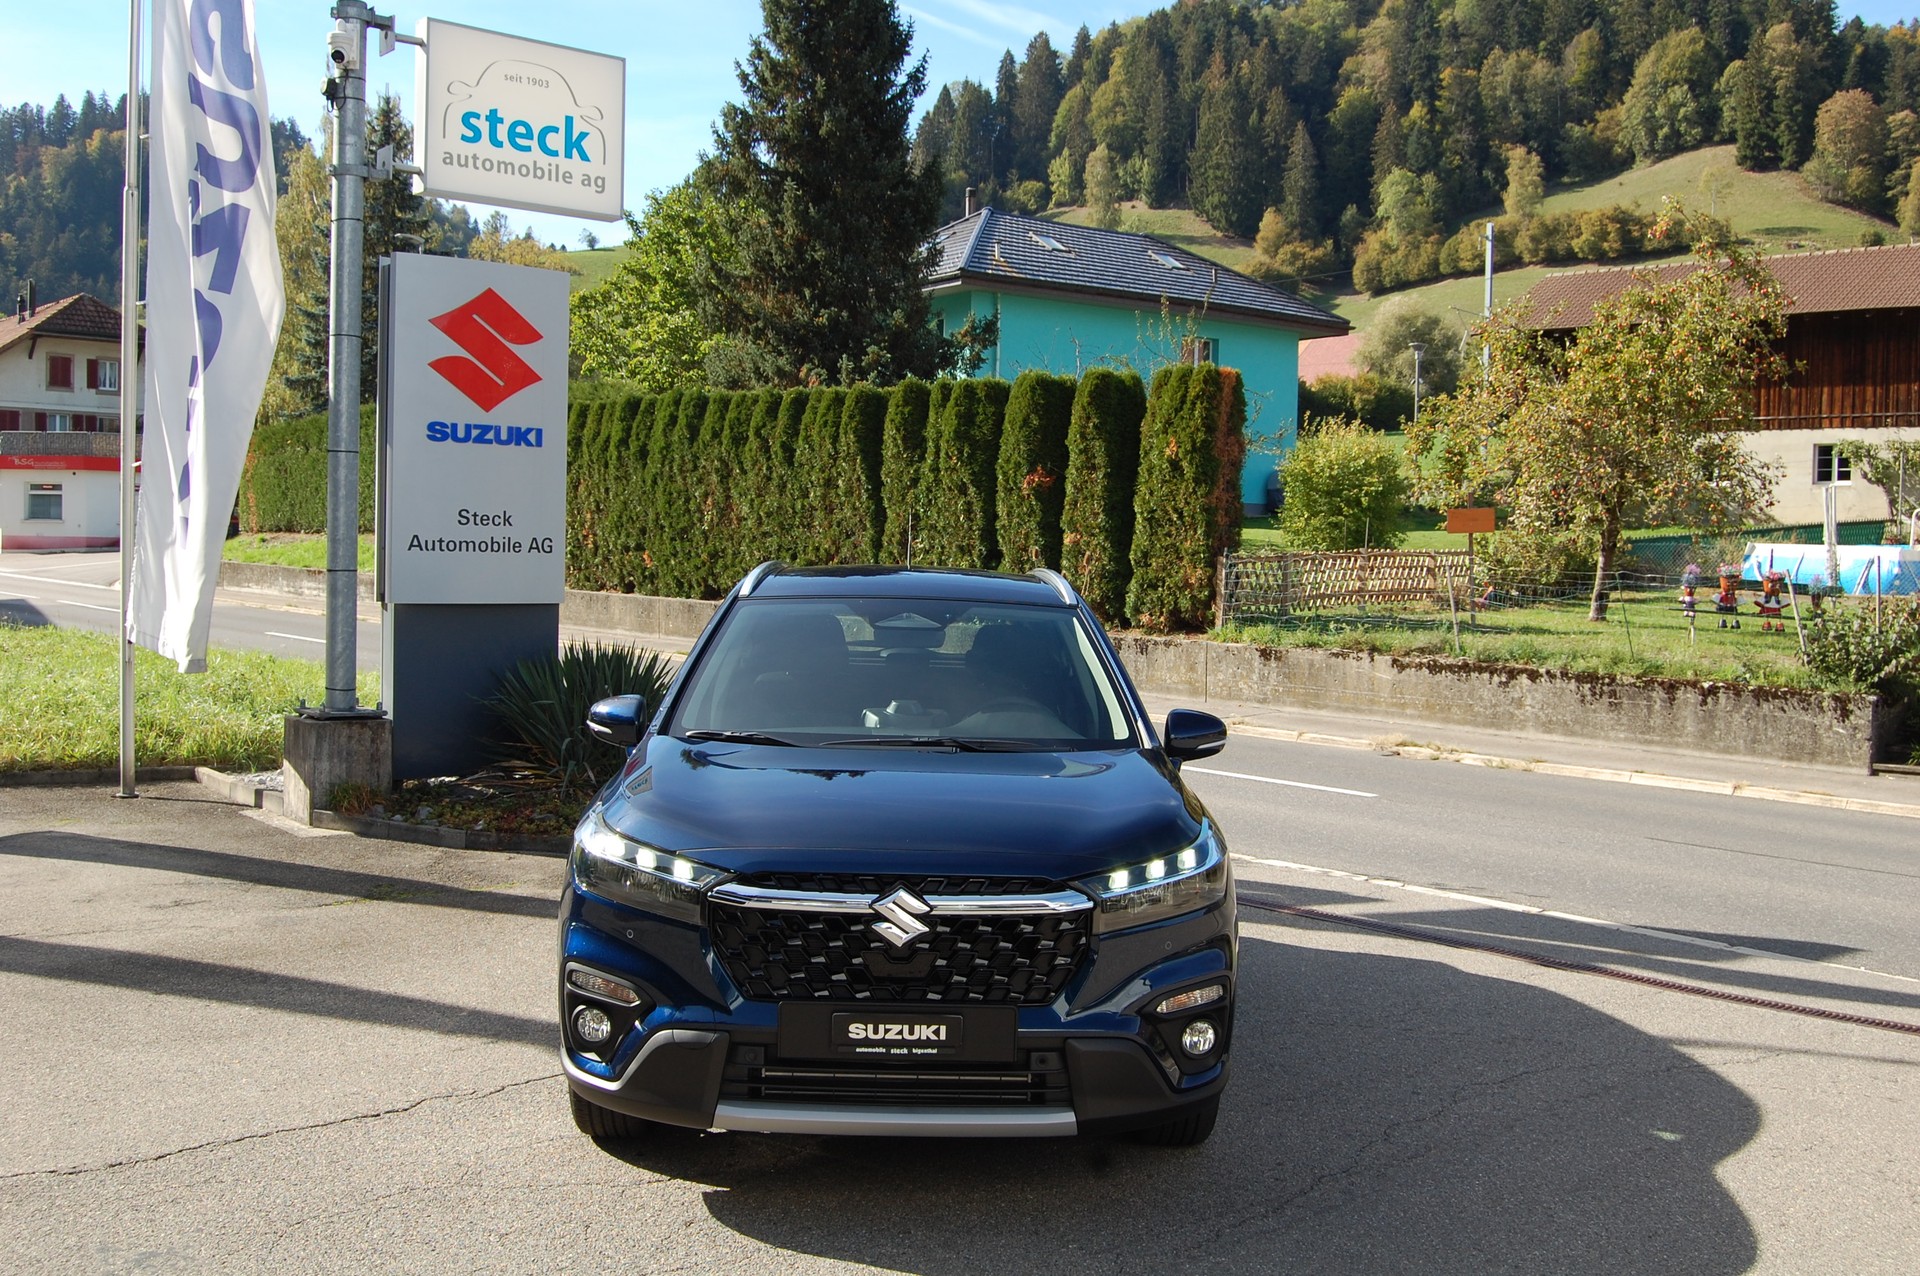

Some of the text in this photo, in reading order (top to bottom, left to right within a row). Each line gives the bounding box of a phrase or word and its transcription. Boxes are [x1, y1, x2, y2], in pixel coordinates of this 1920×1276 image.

[504, 73, 550, 89] seit 1903
[460, 108, 592, 163] steck
[442, 150, 606, 194] automobile ag
[426, 421, 543, 448] SUZUKI
[457, 508, 513, 527] Steck
[407, 534, 553, 554] Automobile AG
[848, 1023, 947, 1041] SUZUKI
[890, 1047, 909, 1055] steck
